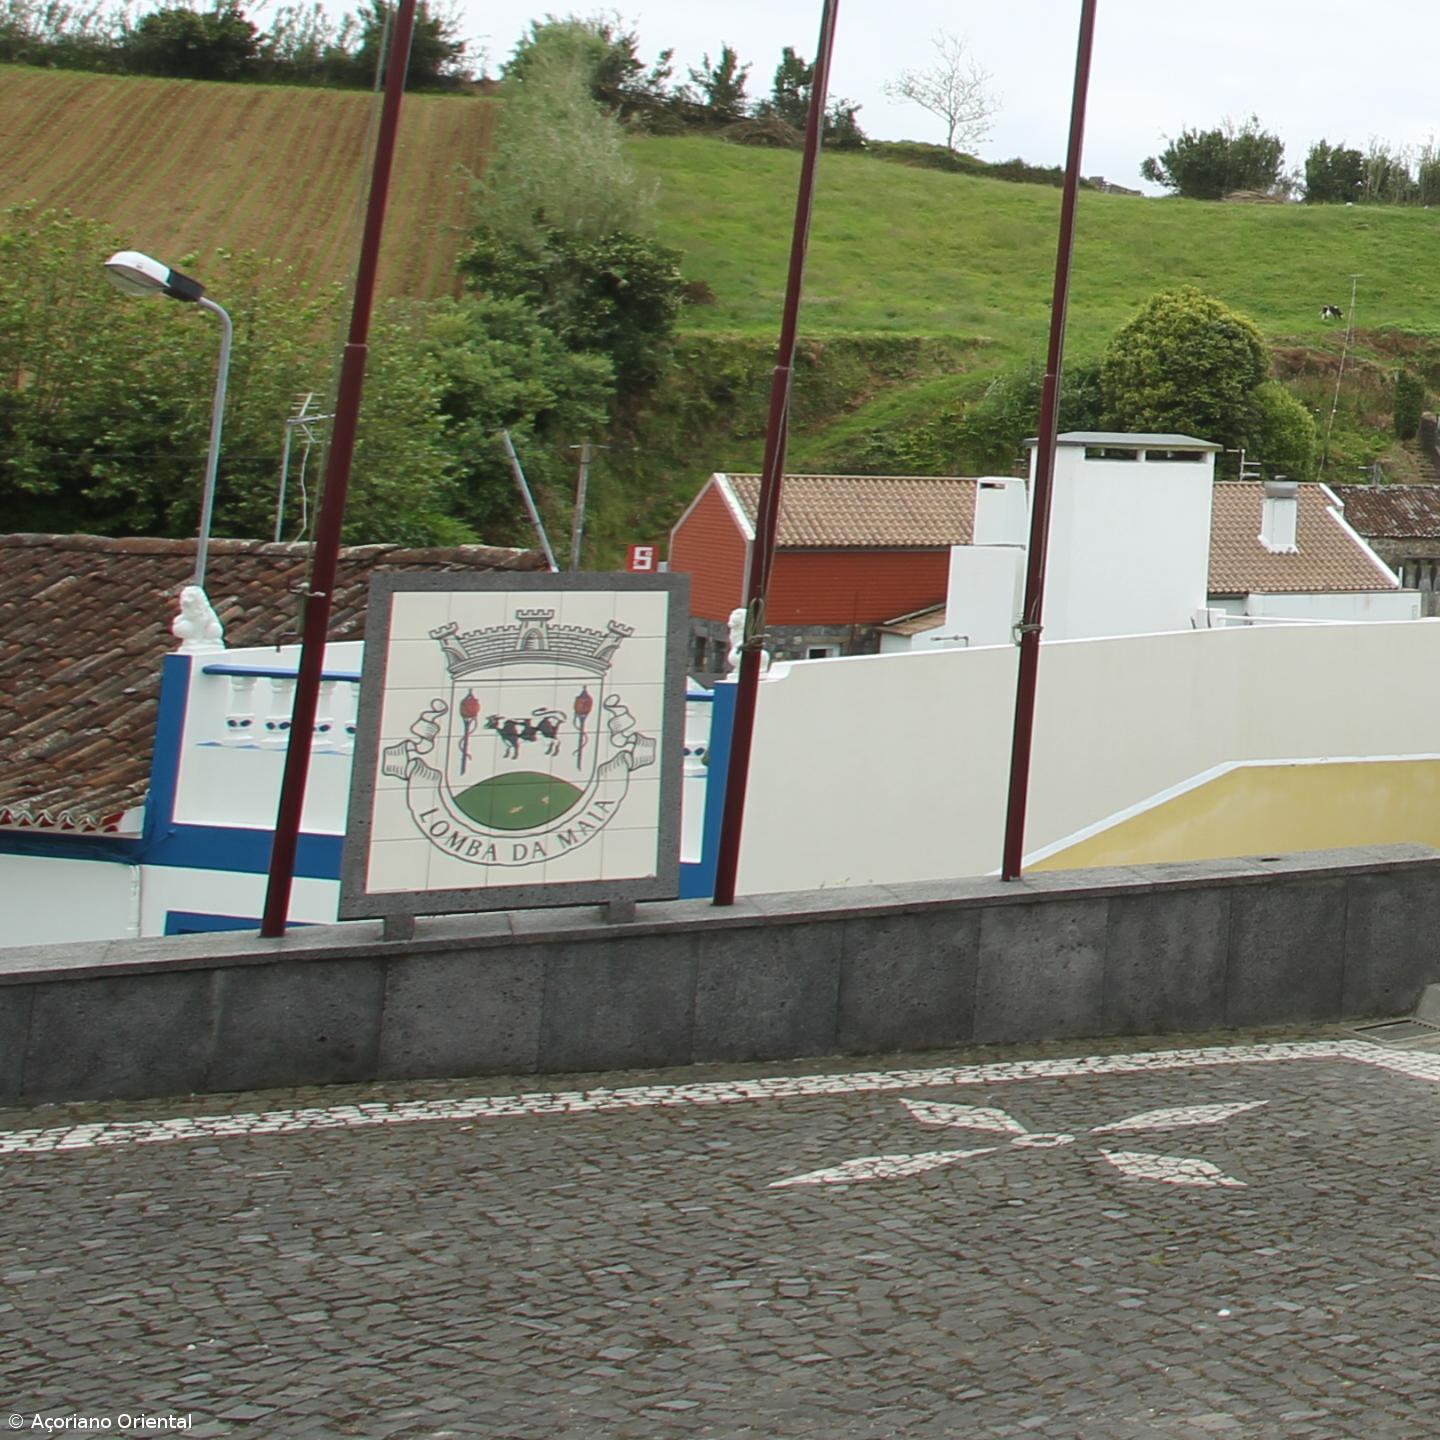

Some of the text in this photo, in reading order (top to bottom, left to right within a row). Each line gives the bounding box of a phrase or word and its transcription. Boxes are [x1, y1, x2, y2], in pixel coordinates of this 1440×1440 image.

[419, 799, 615, 861] LOMBA DA MAIA
